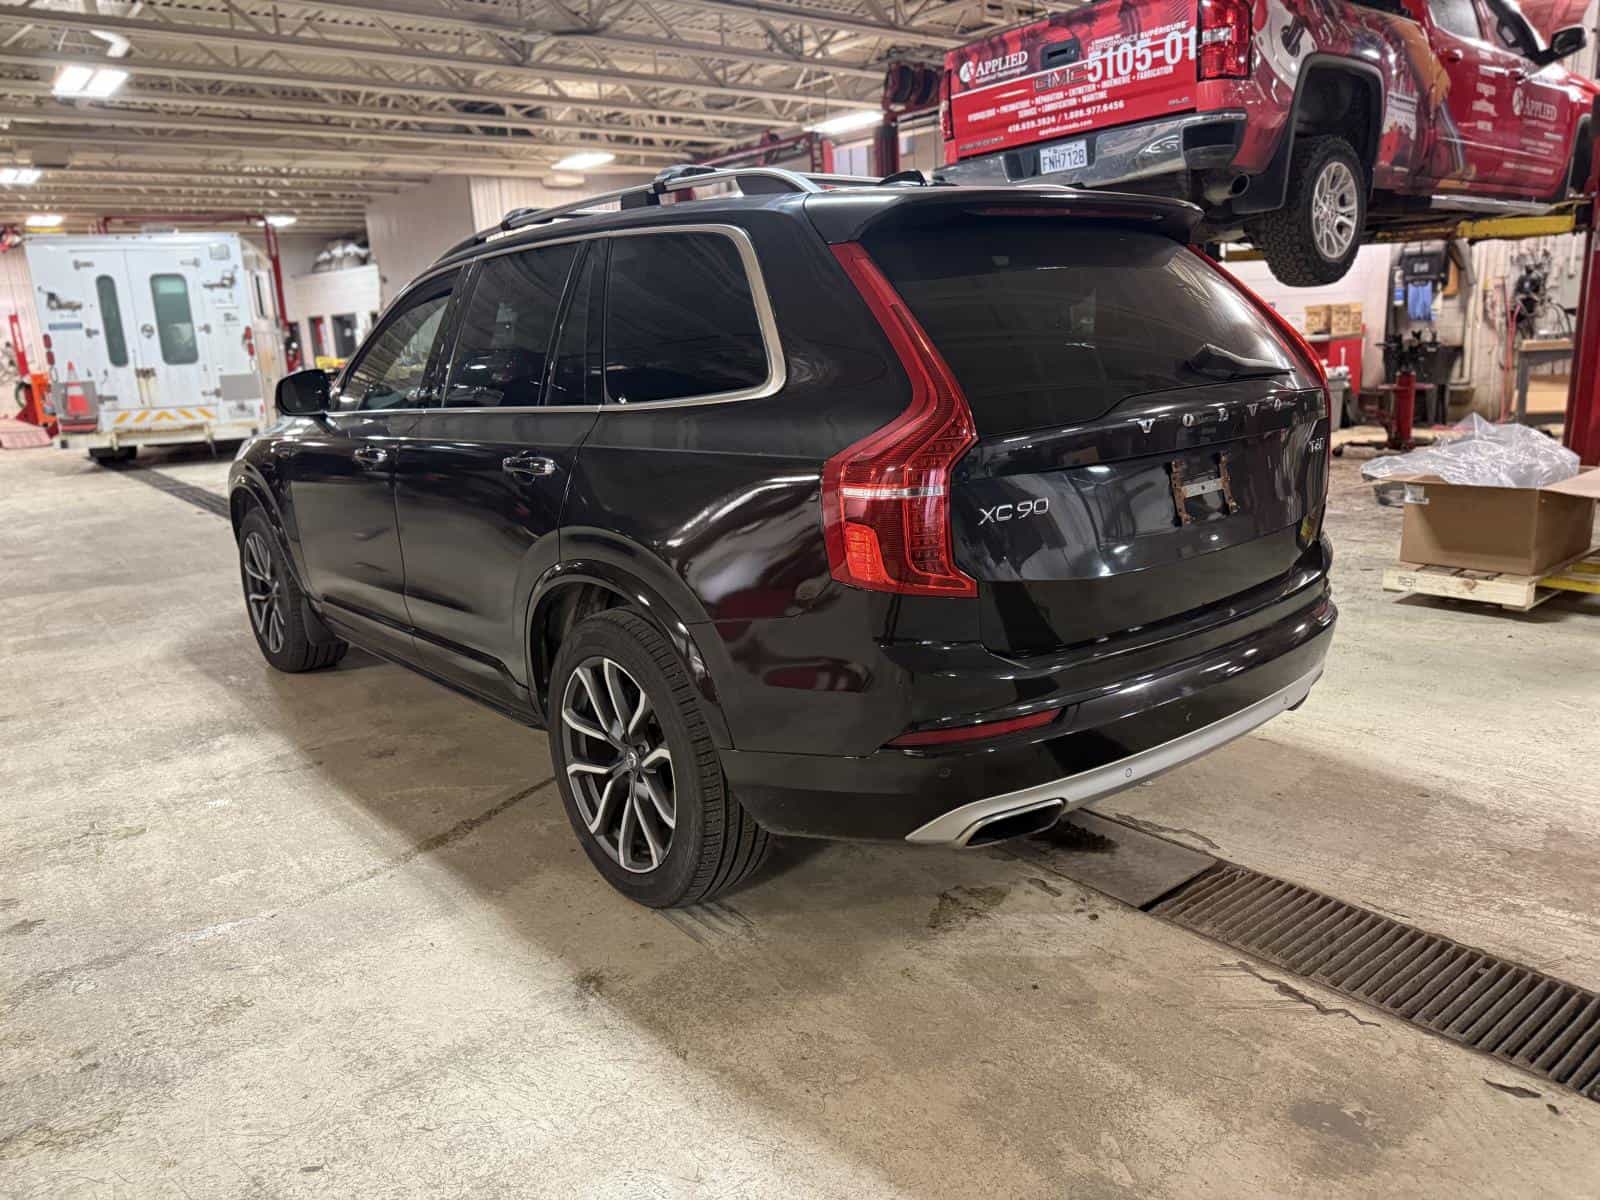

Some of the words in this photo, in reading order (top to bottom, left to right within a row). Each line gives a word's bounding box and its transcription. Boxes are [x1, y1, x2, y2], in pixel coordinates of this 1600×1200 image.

[976, 50, 1029, 77] APPLIED
[1087, 26, 1196, 82] 5105-01
[1041, 149, 1086, 172] FNH7128
[1136, 398, 1283, 434] VOLVO
